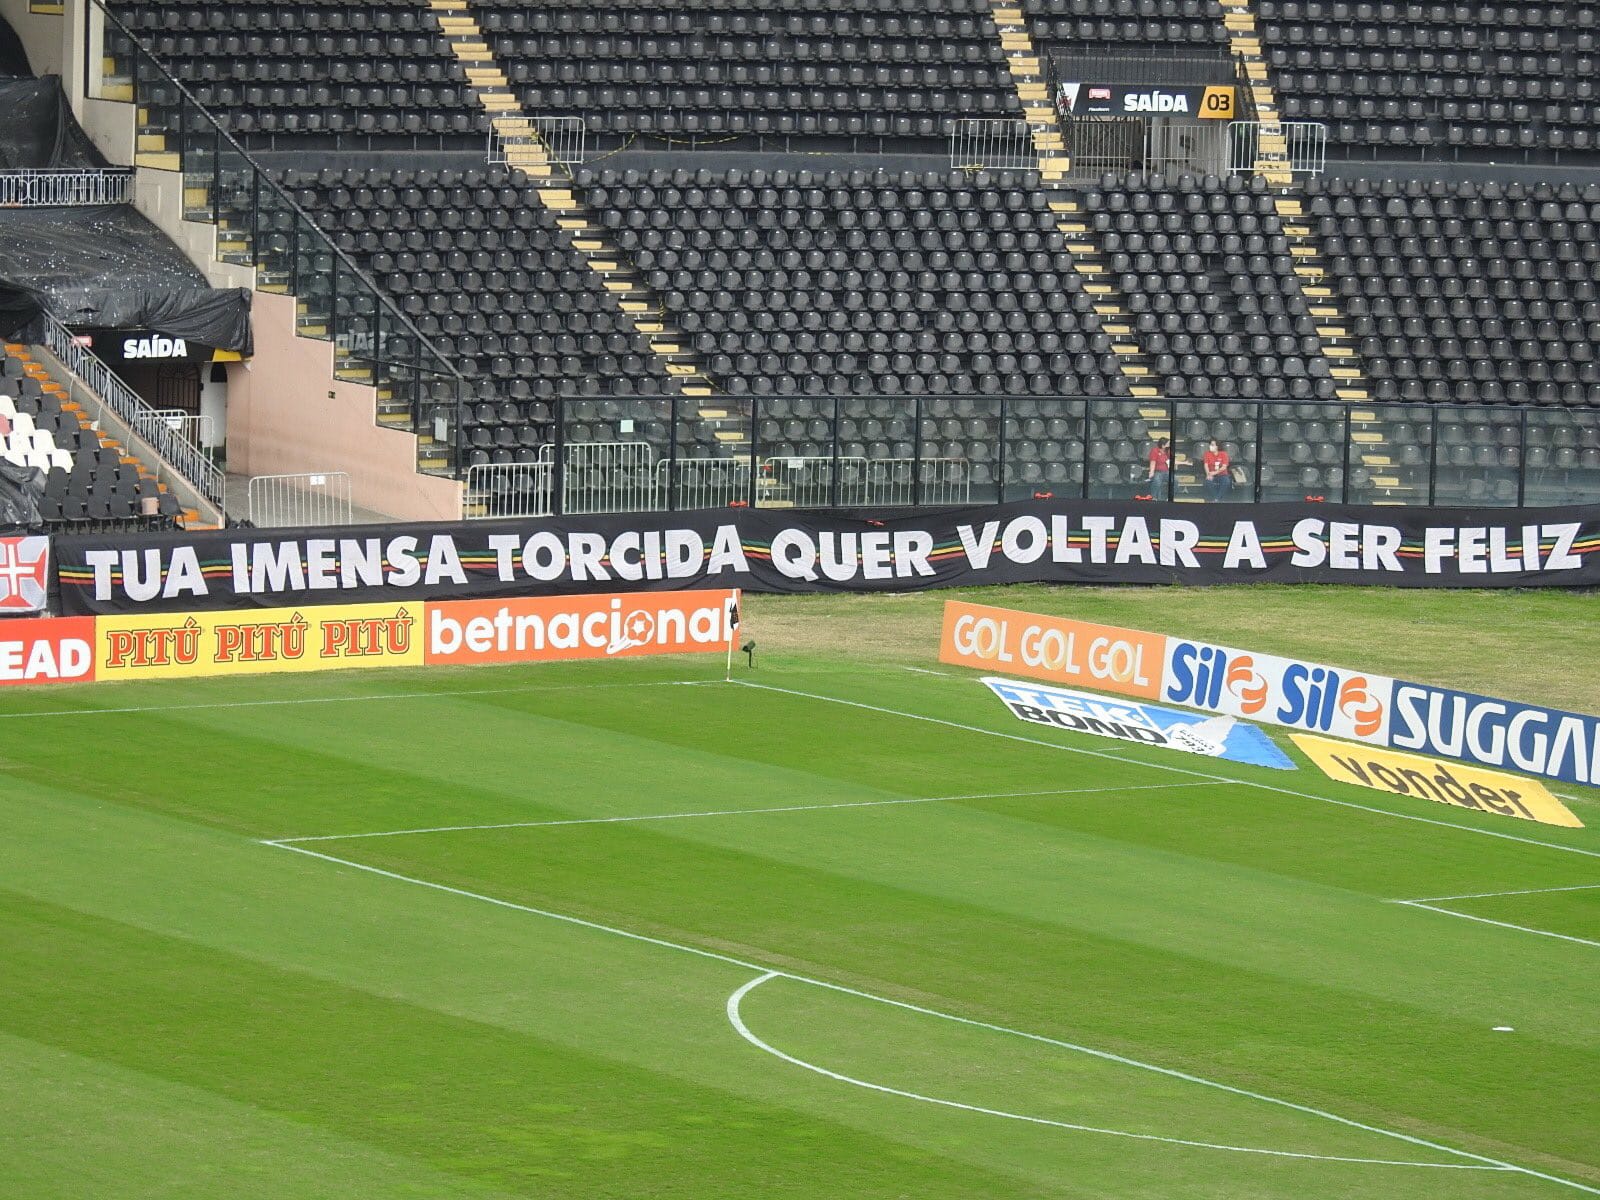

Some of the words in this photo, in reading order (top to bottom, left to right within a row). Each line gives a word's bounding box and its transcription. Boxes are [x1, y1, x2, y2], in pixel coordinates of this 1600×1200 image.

[1124, 90, 1188, 112] SAÍDA
[1208, 94, 1230, 112] 03
[123, 334, 187, 359] SAÍDA
[86, 546, 208, 601] TUA
[230, 534, 468, 593] IMENSA
[489, 524, 750, 582] TORCIDA
[771, 528, 937, 582] QUER
[957, 515, 1200, 569] VOLTAR
[1222, 521, 1267, 569] A
[1291, 518, 1403, 571] SER
[1424, 522, 1582, 574] FELIZ
[106, 616, 201, 668] PITÚ
[214, 611, 308, 663] PITÚ
[320, 607, 413, 658] PITÚ
[431, 598, 737, 654] betnacional
[953, 614, 1013, 663] GOL
[1021, 625, 1081, 674] GOL
[1088, 637, 1149, 687] GOL
[1010, 703, 1168, 744] BOND
[1330, 753, 1535, 819] vonder
